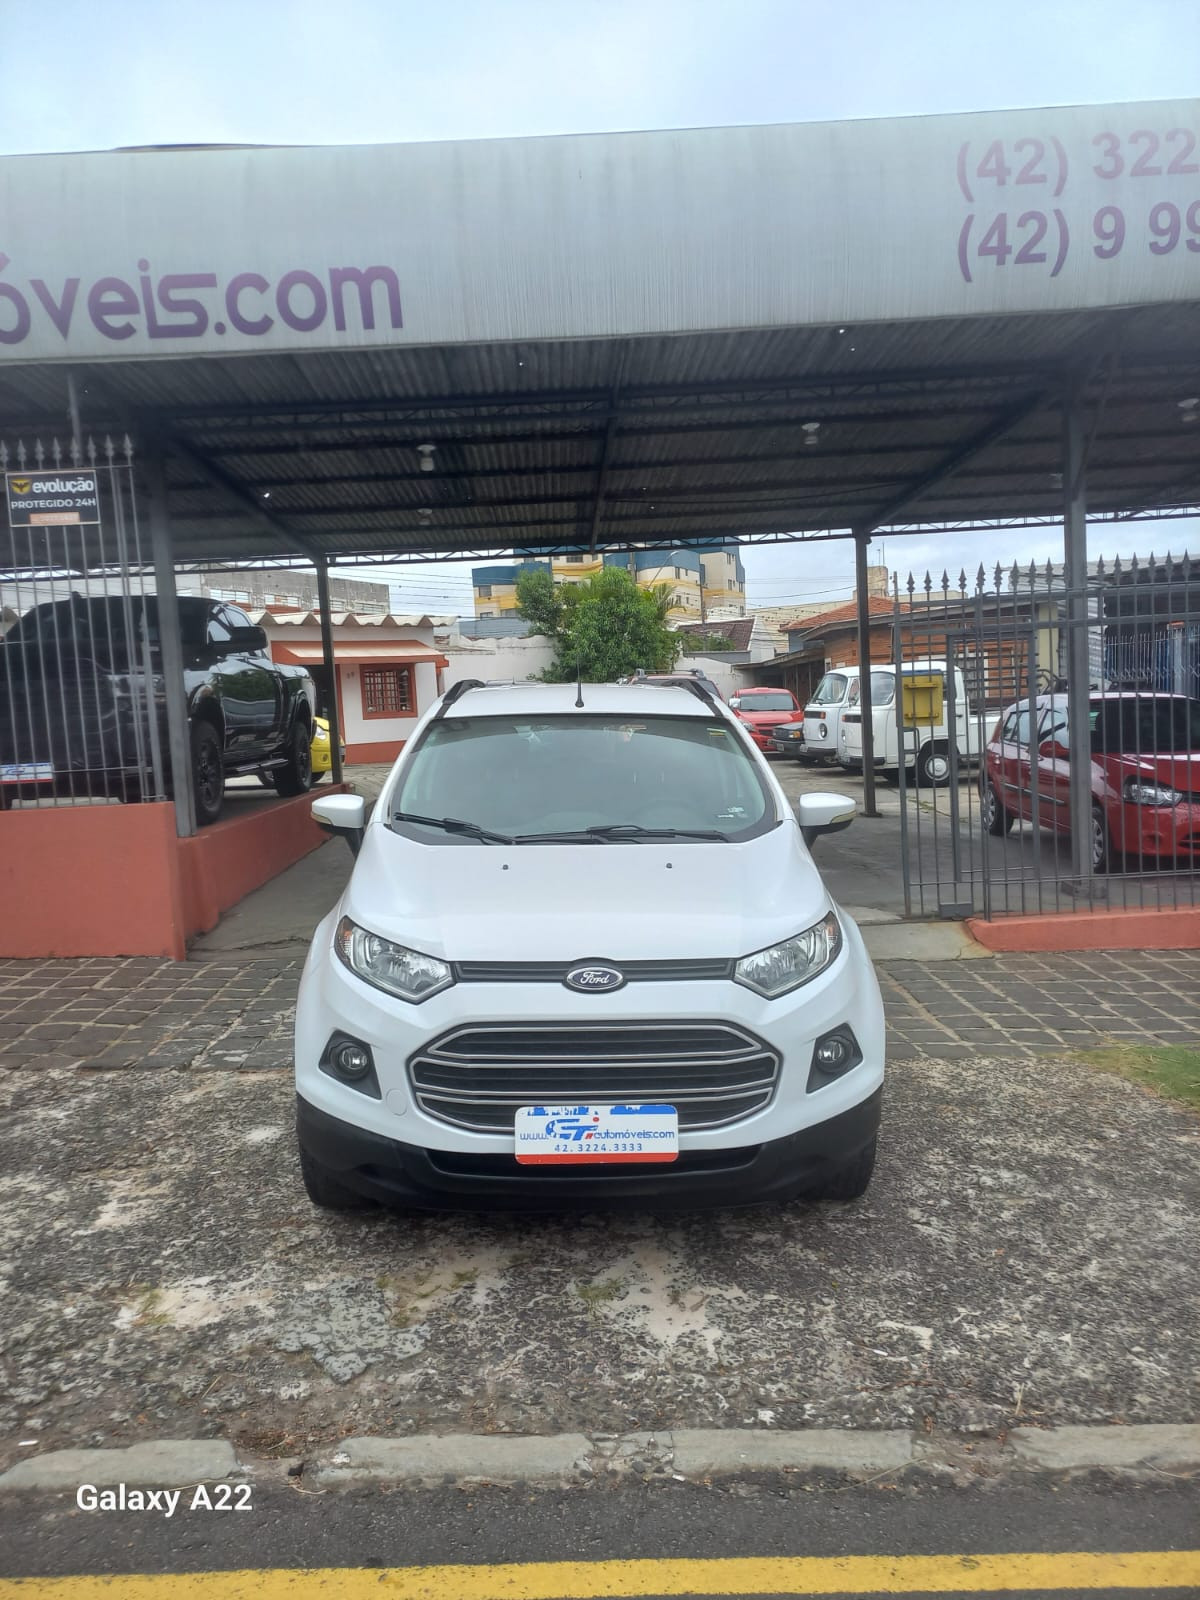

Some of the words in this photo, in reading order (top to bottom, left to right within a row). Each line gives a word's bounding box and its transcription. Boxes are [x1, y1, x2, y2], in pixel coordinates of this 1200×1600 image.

[957, 136, 1068, 202] (42)
[1091, 128, 1200, 180] 322
[958, 208, 1070, 283] (42)
[1093, 206, 1126, 259] 9
[32, 477, 94, 493] evolução
[11, 499, 73, 509] PROTEGIDO
[75, 498, 96, 507] 24H
[580, 971, 610, 984] Ford
